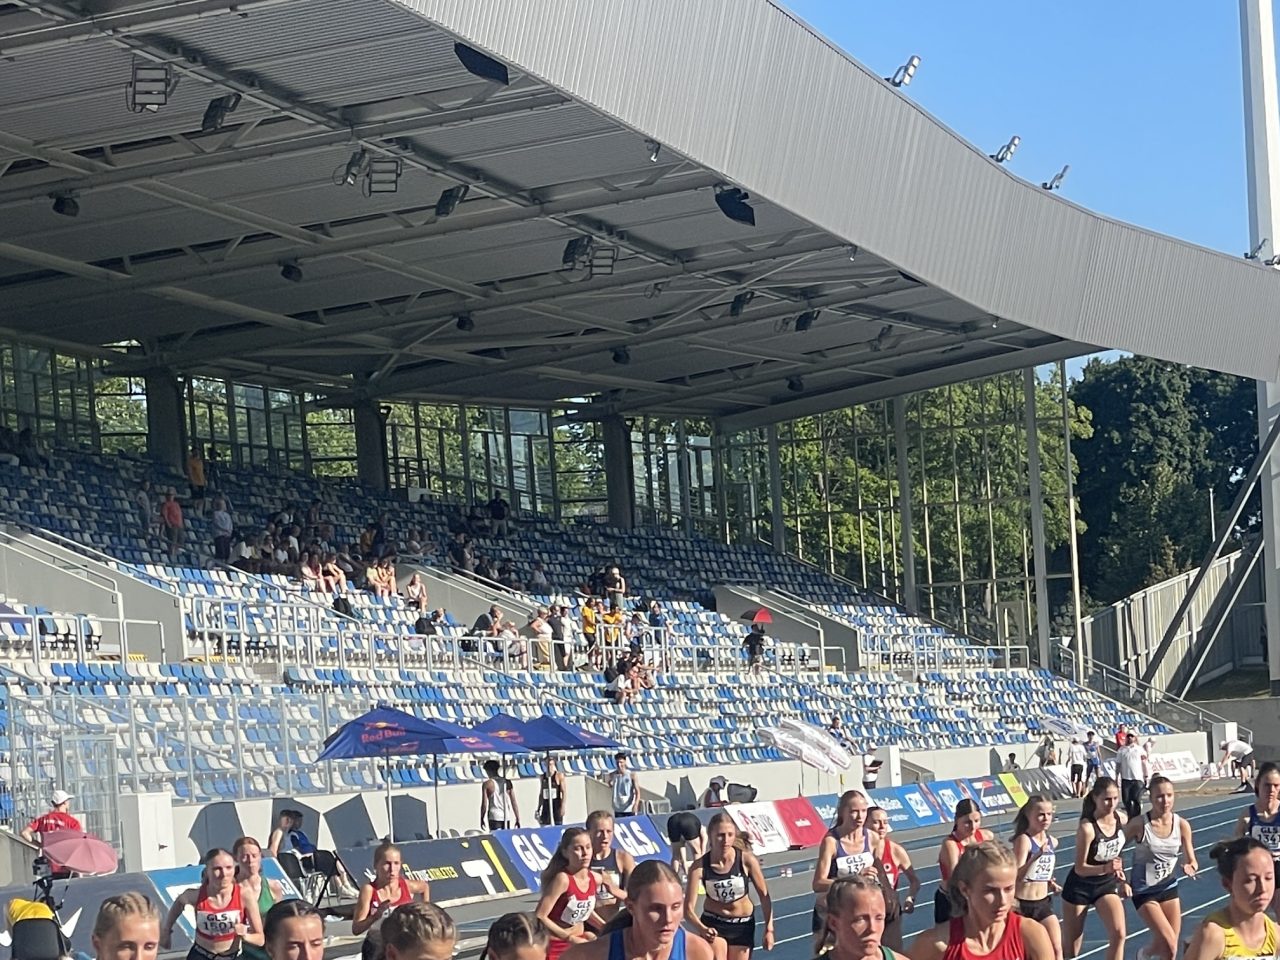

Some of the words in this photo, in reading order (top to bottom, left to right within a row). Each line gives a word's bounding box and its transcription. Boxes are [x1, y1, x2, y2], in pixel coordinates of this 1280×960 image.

[361, 732, 383, 743] Red
[384, 729, 406, 740] Bull
[1260, 826, 1279, 834] GLS
[845, 856, 864, 865] GLS
[713, 880, 733, 889] GLS
[576, 901, 591, 909] GLS
